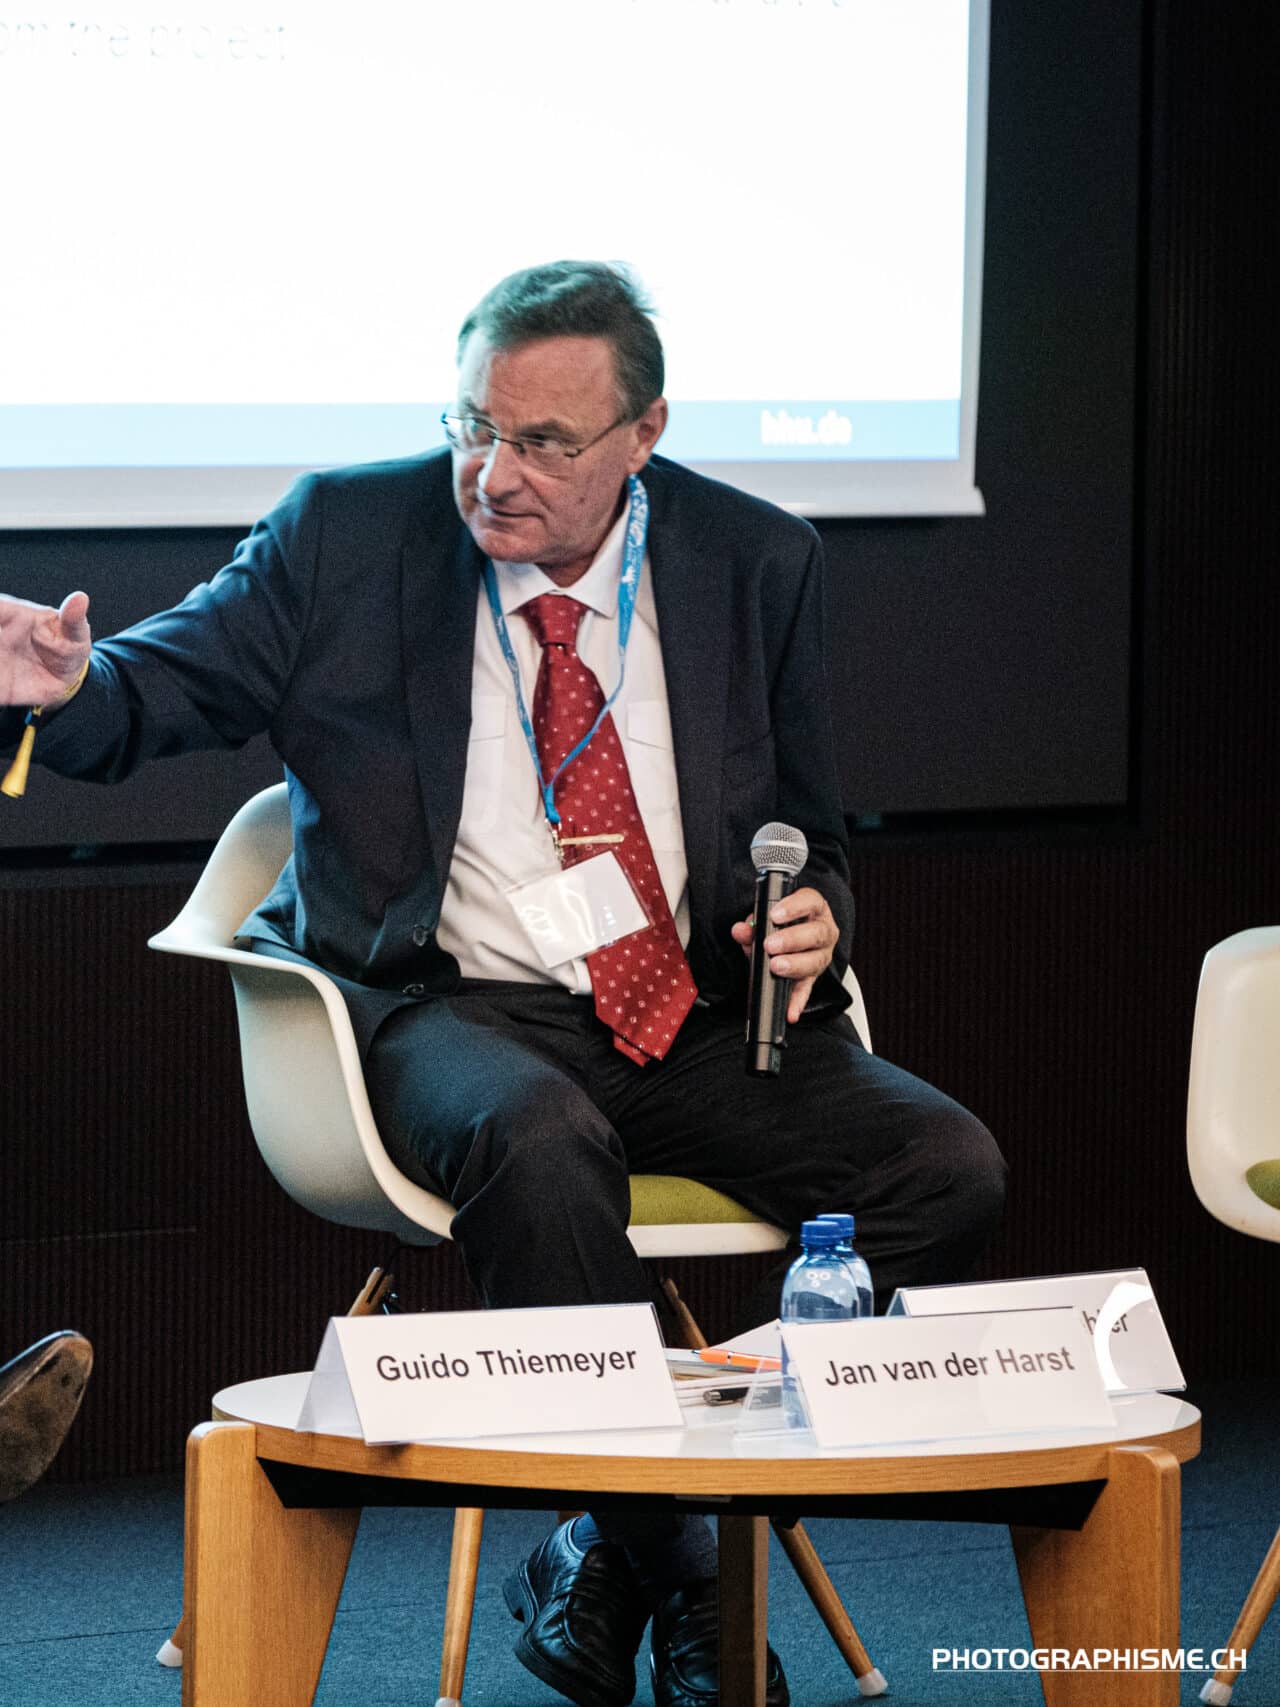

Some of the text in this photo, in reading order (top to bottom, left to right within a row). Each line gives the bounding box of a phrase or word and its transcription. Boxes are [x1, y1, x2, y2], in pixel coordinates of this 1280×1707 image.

[145, 20, 289, 72] proect
[1081, 1309, 1128, 1335] her
[376, 1348, 637, 1381] Guido Thiemeyer
[825, 1346, 1076, 1386] Jan van der Harst
